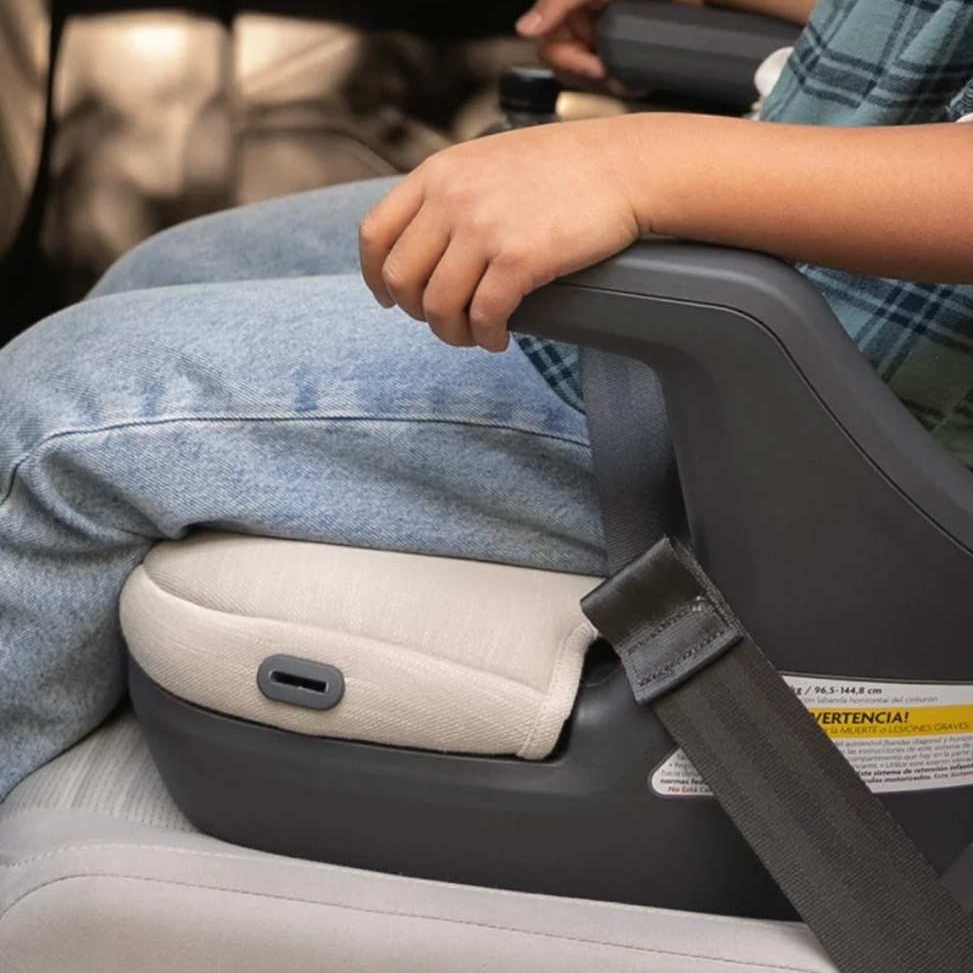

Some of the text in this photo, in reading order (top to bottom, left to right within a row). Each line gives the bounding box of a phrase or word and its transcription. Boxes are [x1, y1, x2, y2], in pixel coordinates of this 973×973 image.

[805, 686, 812, 696] /
[814, 687, 865, 695] 96,5-144,8
[888, 724, 932, 734] LESIONES
[845, 739, 882, 747] automóvil
[912, 737, 941, 746] diagonal
[859, 747, 905, 755] instrucciones
[919, 752, 931, 760] hay
[951, 749, 969, 759] parte
[662, 768, 680, 776] hacia
[914, 765, 948, 773] retención
